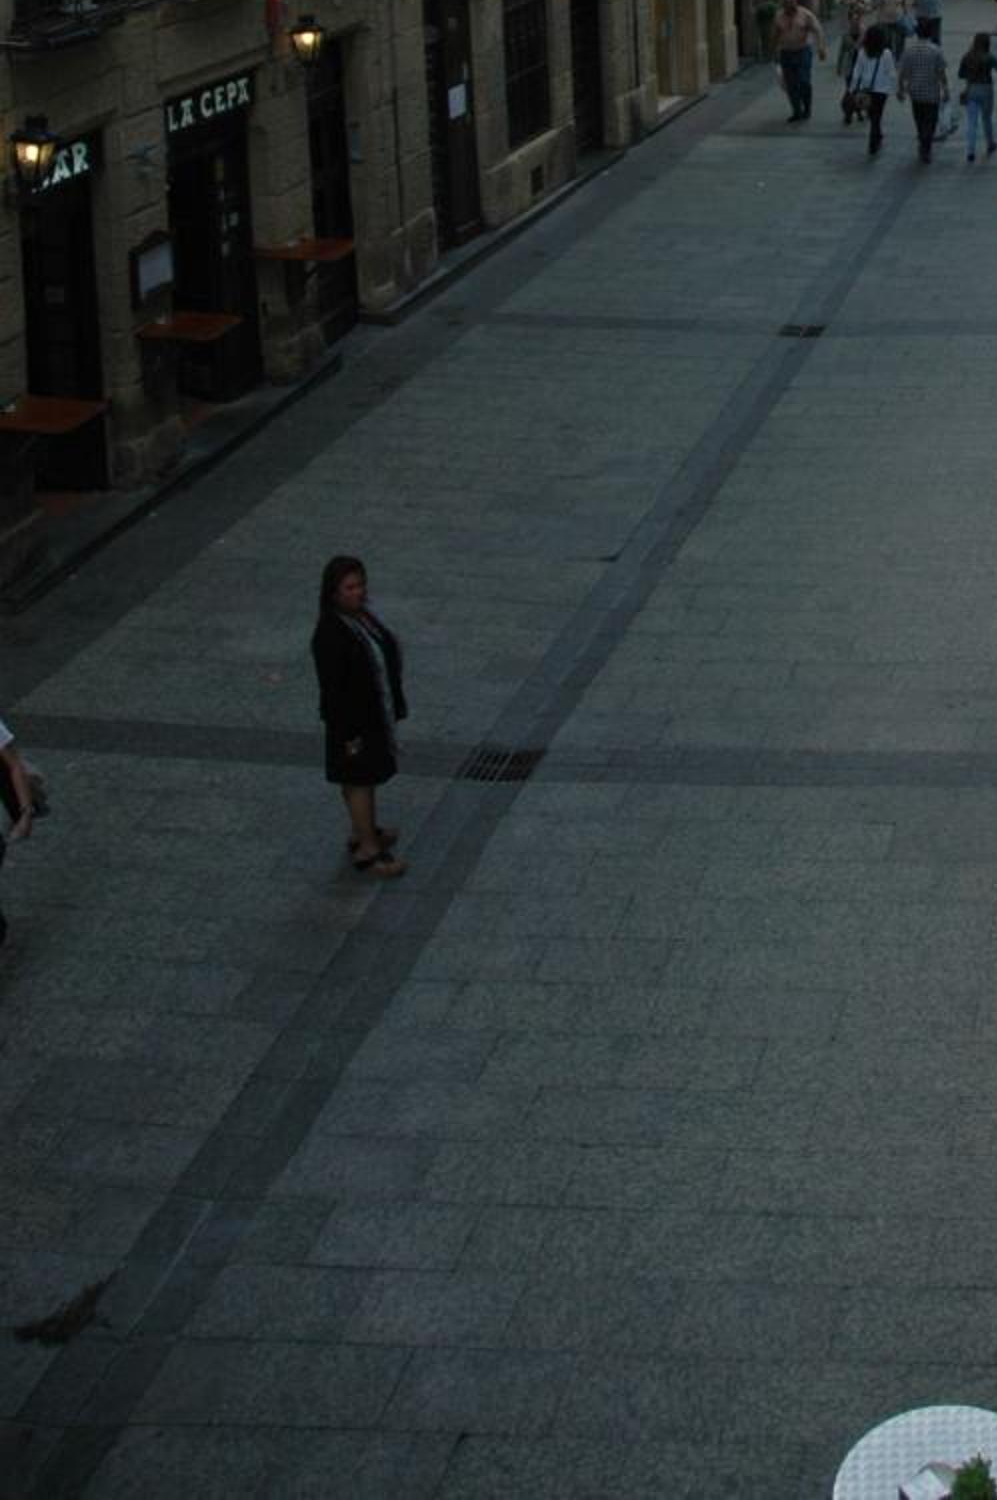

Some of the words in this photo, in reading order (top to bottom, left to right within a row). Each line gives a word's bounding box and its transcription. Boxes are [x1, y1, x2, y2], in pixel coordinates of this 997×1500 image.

[167, 98, 195, 133] LA
[200, 77, 249, 118] CEPA
[31, 141, 90, 194] AR
